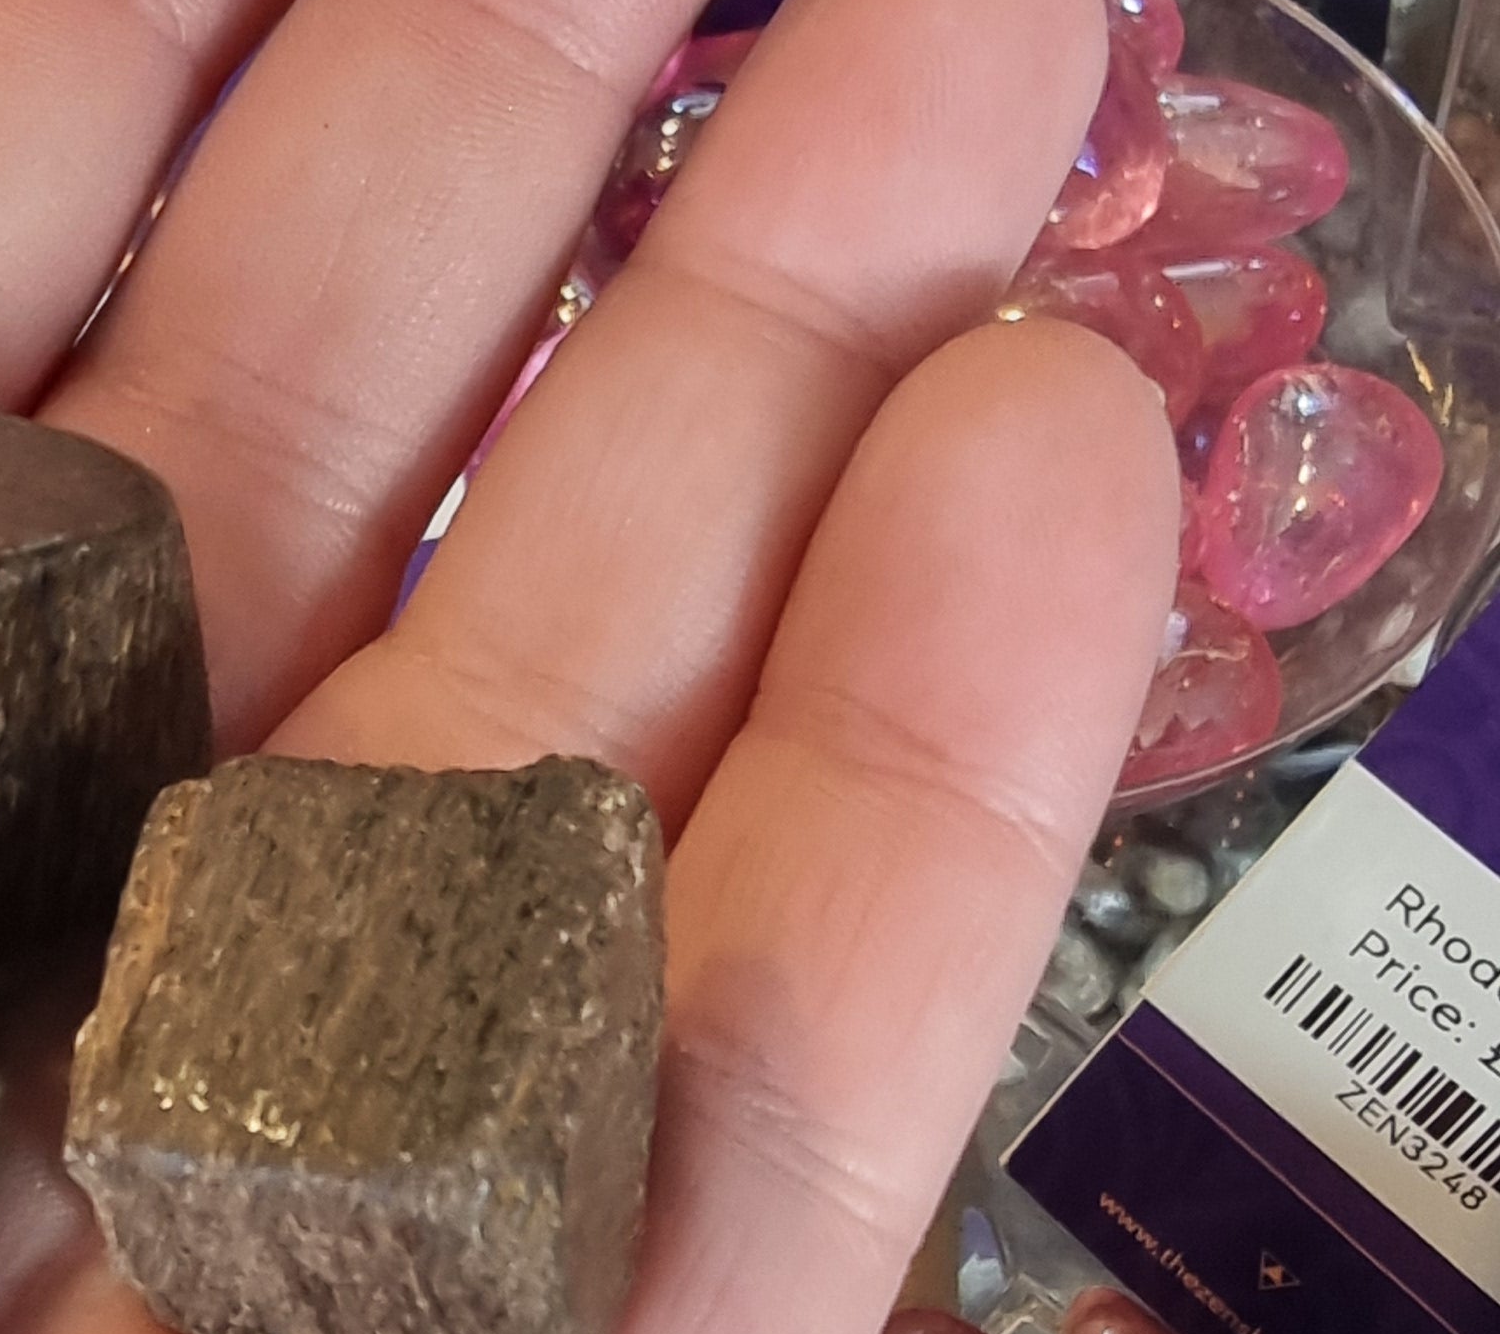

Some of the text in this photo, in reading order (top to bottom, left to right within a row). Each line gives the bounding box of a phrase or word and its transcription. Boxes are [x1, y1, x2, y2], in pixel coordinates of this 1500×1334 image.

[1349, 928, 1476, 1044] Price:
[1385, 883, 1500, 1003] Rhod
[1335, 1079, 1488, 1211] ZEN3248
